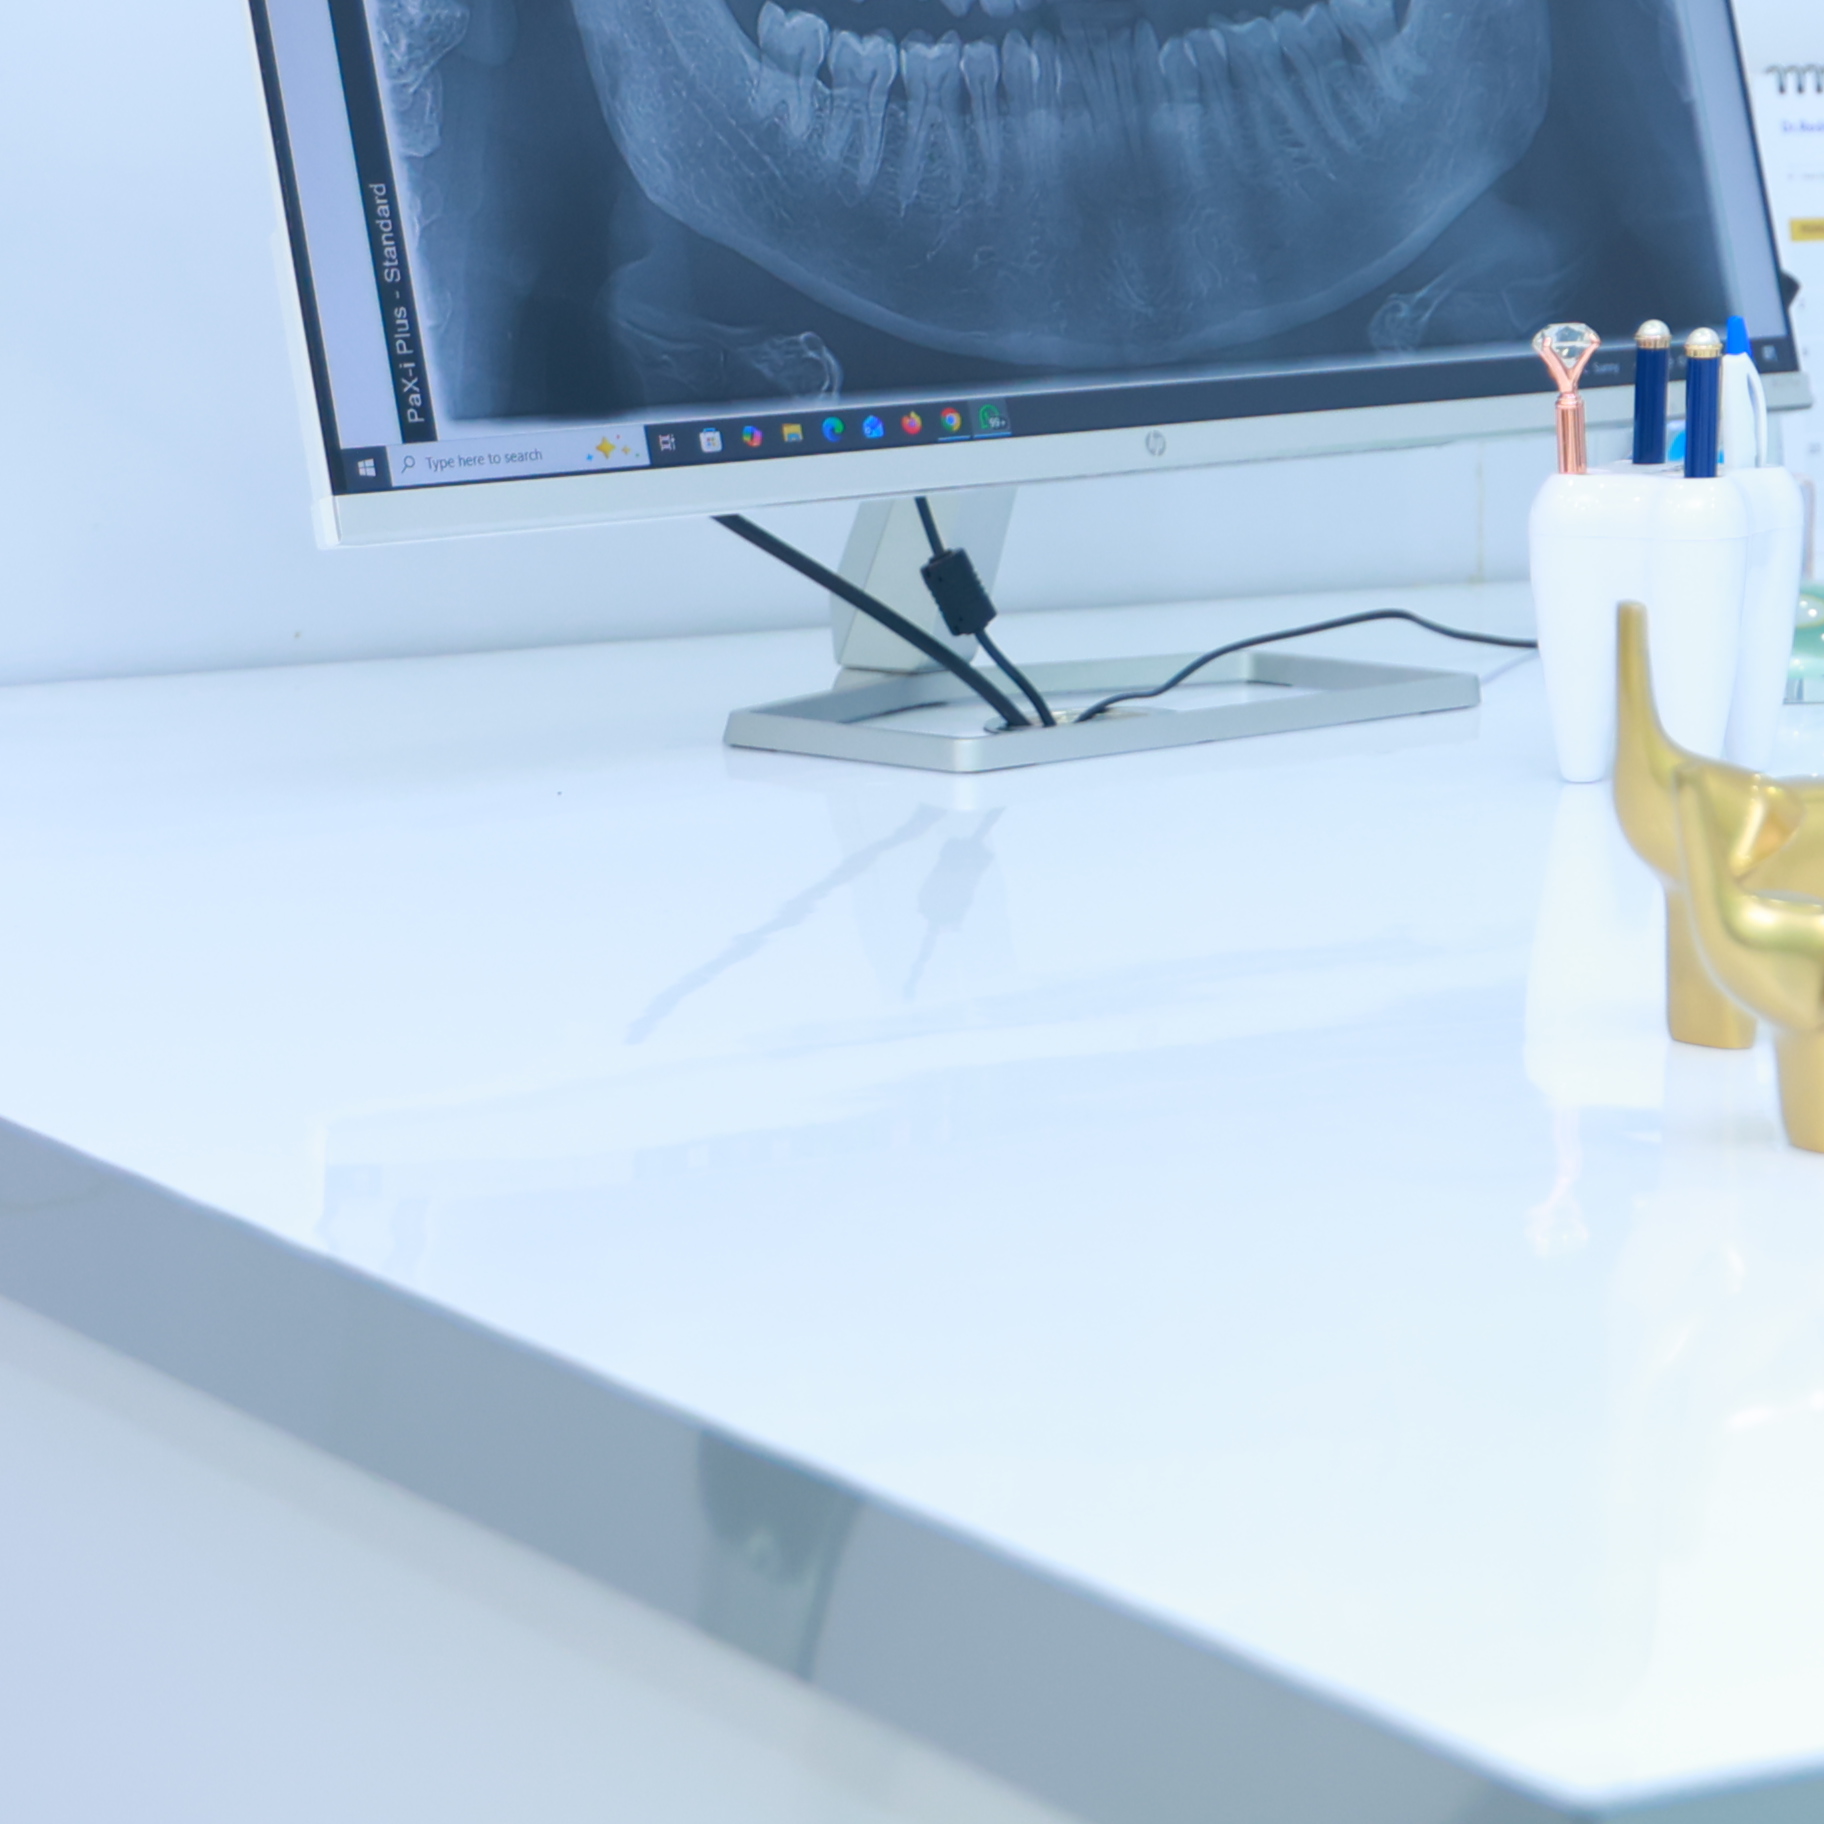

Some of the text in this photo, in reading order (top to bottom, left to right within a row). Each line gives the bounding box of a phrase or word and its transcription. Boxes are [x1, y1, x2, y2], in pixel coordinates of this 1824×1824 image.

[368, 182, 401, 283] Standard
[393, 306, 414, 355] Plus
[399, 362, 425, 424] PaX-i
[426, 448, 543, 472] Type here to search
